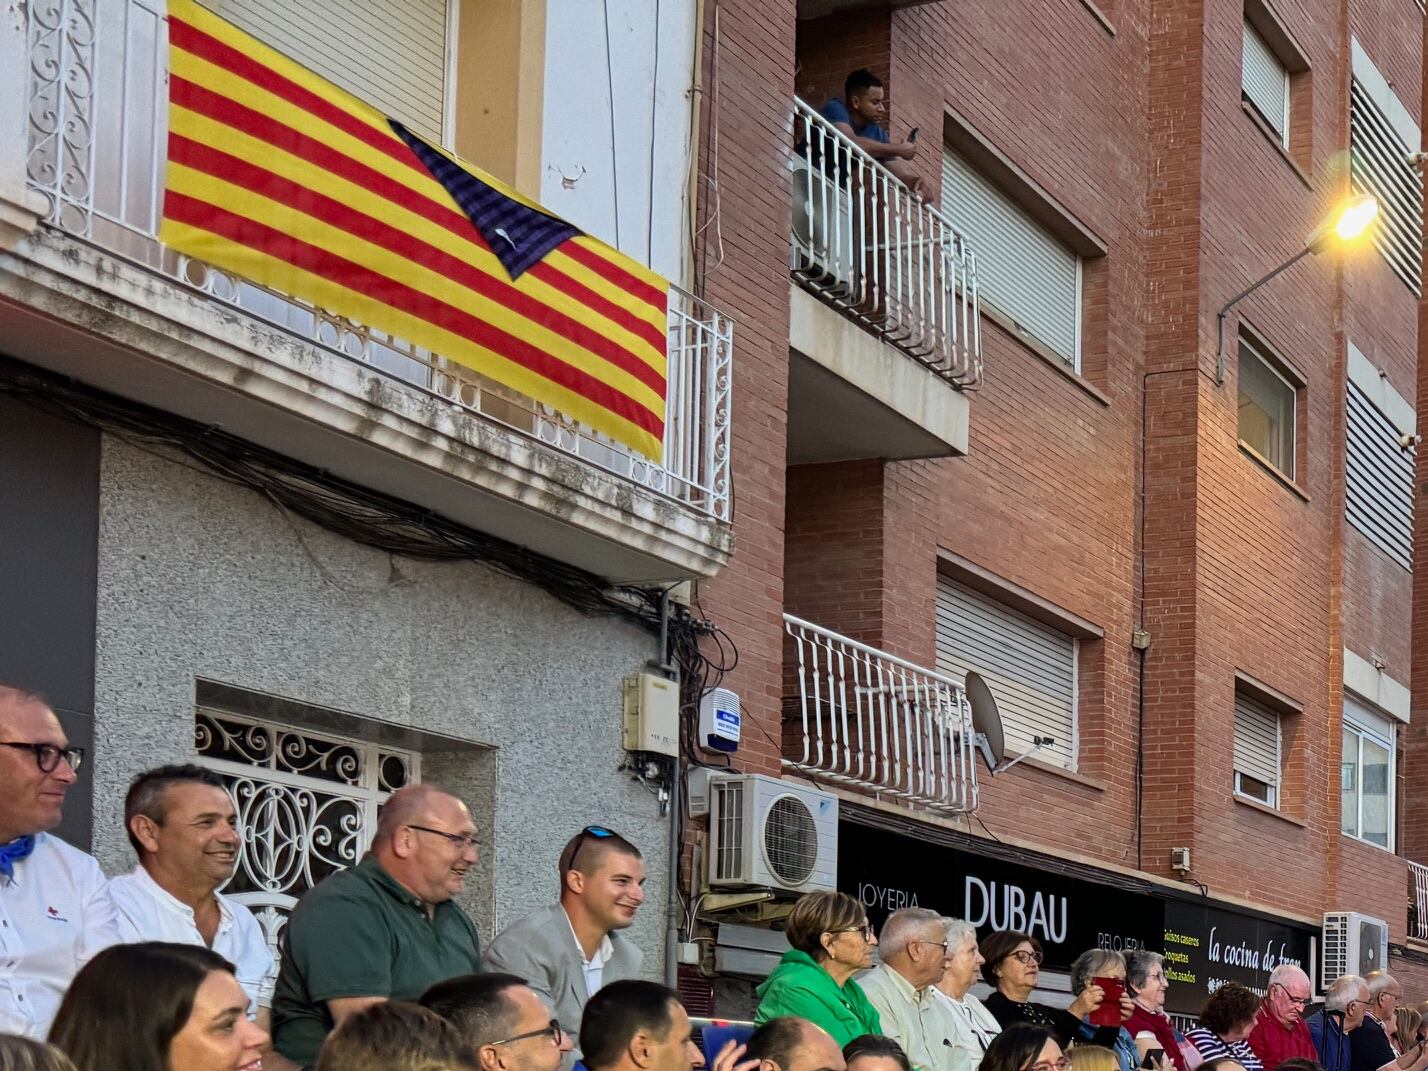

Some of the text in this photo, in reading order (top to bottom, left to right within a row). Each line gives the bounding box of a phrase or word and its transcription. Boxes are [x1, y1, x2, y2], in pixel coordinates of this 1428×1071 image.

[857, 882, 919, 911] JOYERIA
[965, 876, 1067, 943] DUBAU
[1208, 927, 1220, 962] la
[1224, 941, 1259, 970] cocina
[1263, 940, 1275, 973] de
